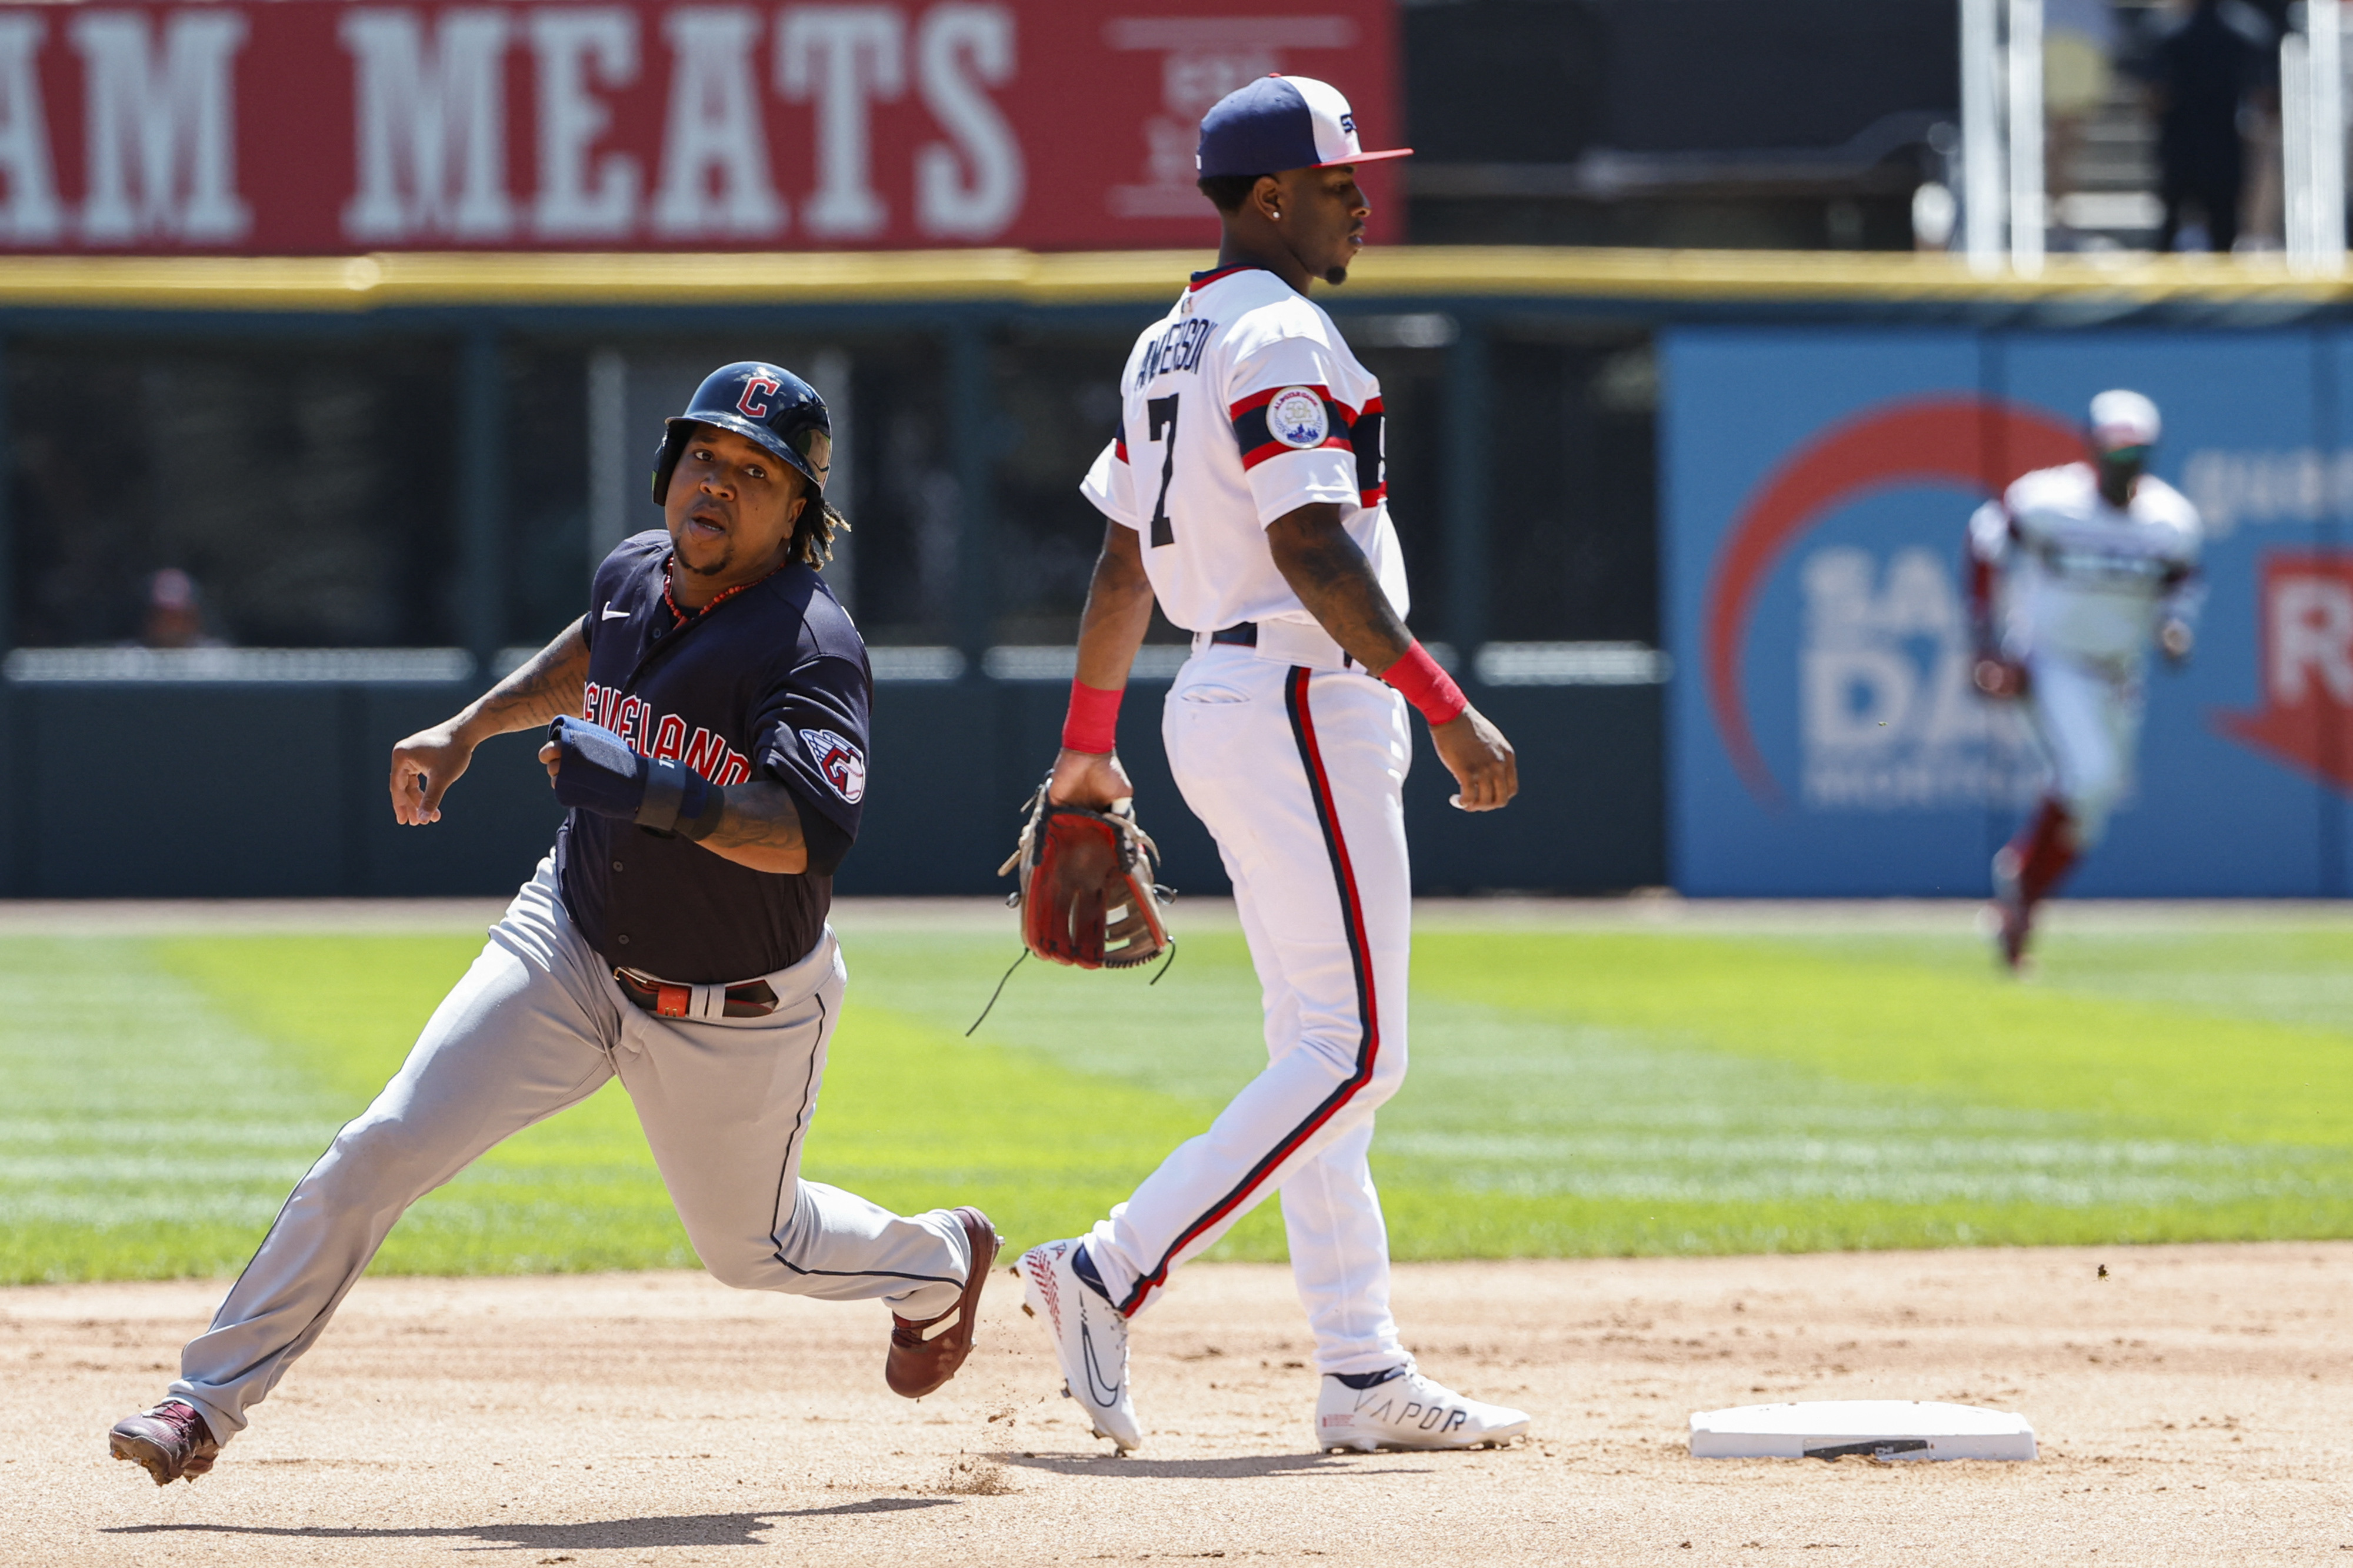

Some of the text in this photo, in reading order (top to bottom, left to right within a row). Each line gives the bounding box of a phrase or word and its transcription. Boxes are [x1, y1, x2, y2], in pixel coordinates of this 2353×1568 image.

[340, 7, 1022, 239] MEATS
[736, 376, 780, 418] C
[1147, 392, 1179, 549] 7
[1354, 1389, 1468, 1433] VAPOR
